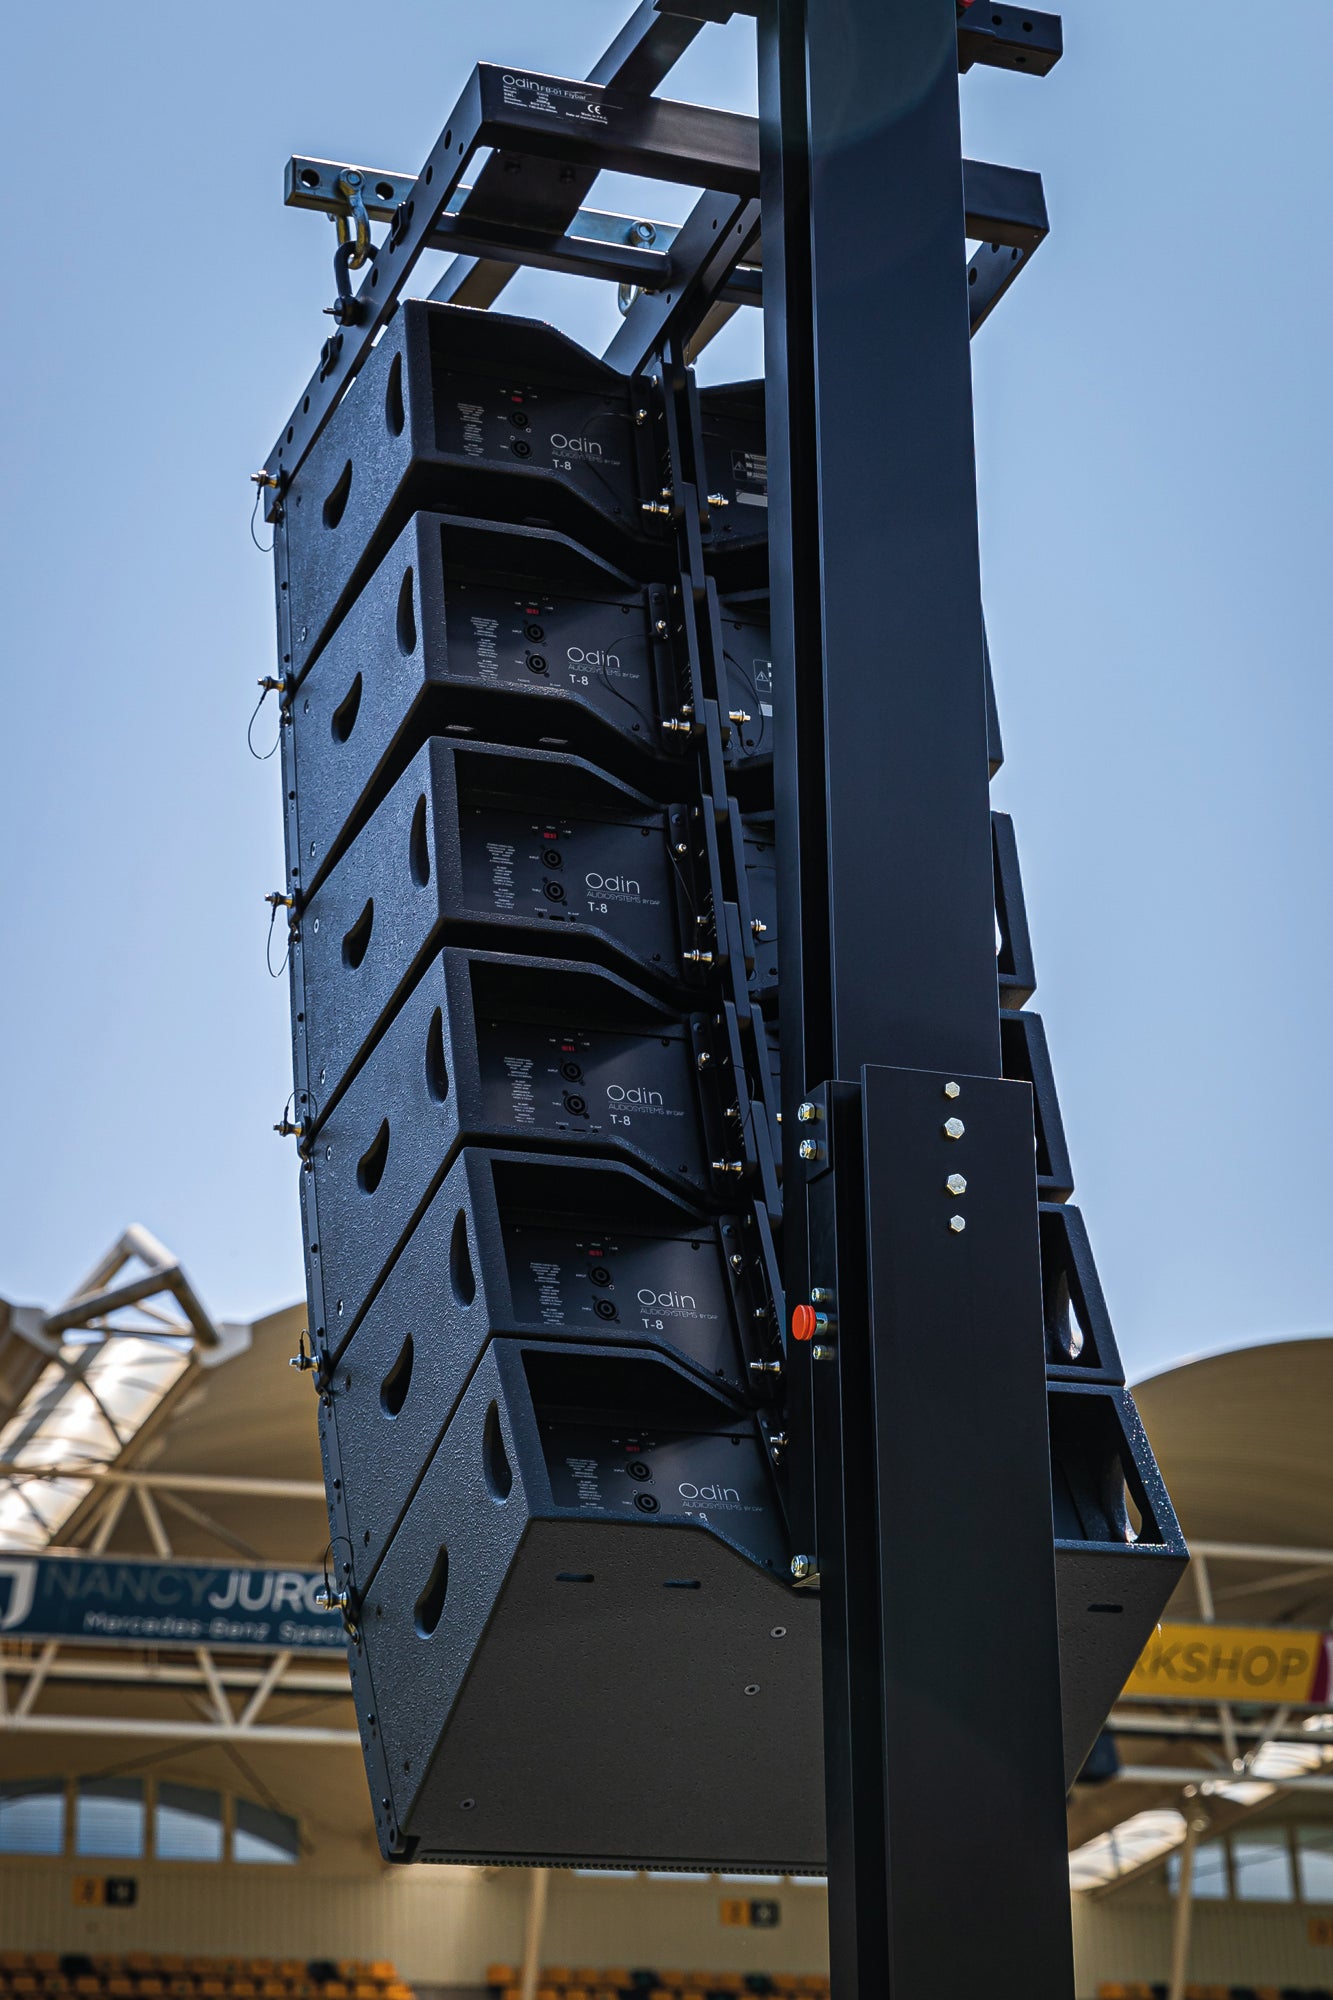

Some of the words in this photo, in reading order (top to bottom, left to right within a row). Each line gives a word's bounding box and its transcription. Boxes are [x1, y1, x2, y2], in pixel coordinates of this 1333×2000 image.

[502, 75, 540, 91] Odin
[550, 434, 602, 455] Odin
[552, 459, 572, 470] T-8
[567, 646, 620, 668] Odin
[569, 674, 589, 686] T-8
[586, 872, 640, 894] Odin
[587, 891, 641, 903] AUDIOSYSTEMS
[587, 902, 608, 913] T-8
[607, 1085, 663, 1105] Odin
[608, 1103, 664, 1115] AUDIOSYSTEMS
[610, 1114, 630, 1126] T-8
[637, 1289, 696, 1309] Odin
[640, 1308, 697, 1319] AUDIOSYSTEMS
[642, 1318, 664, 1330] T-8
[679, 1482, 740, 1502] Odin
